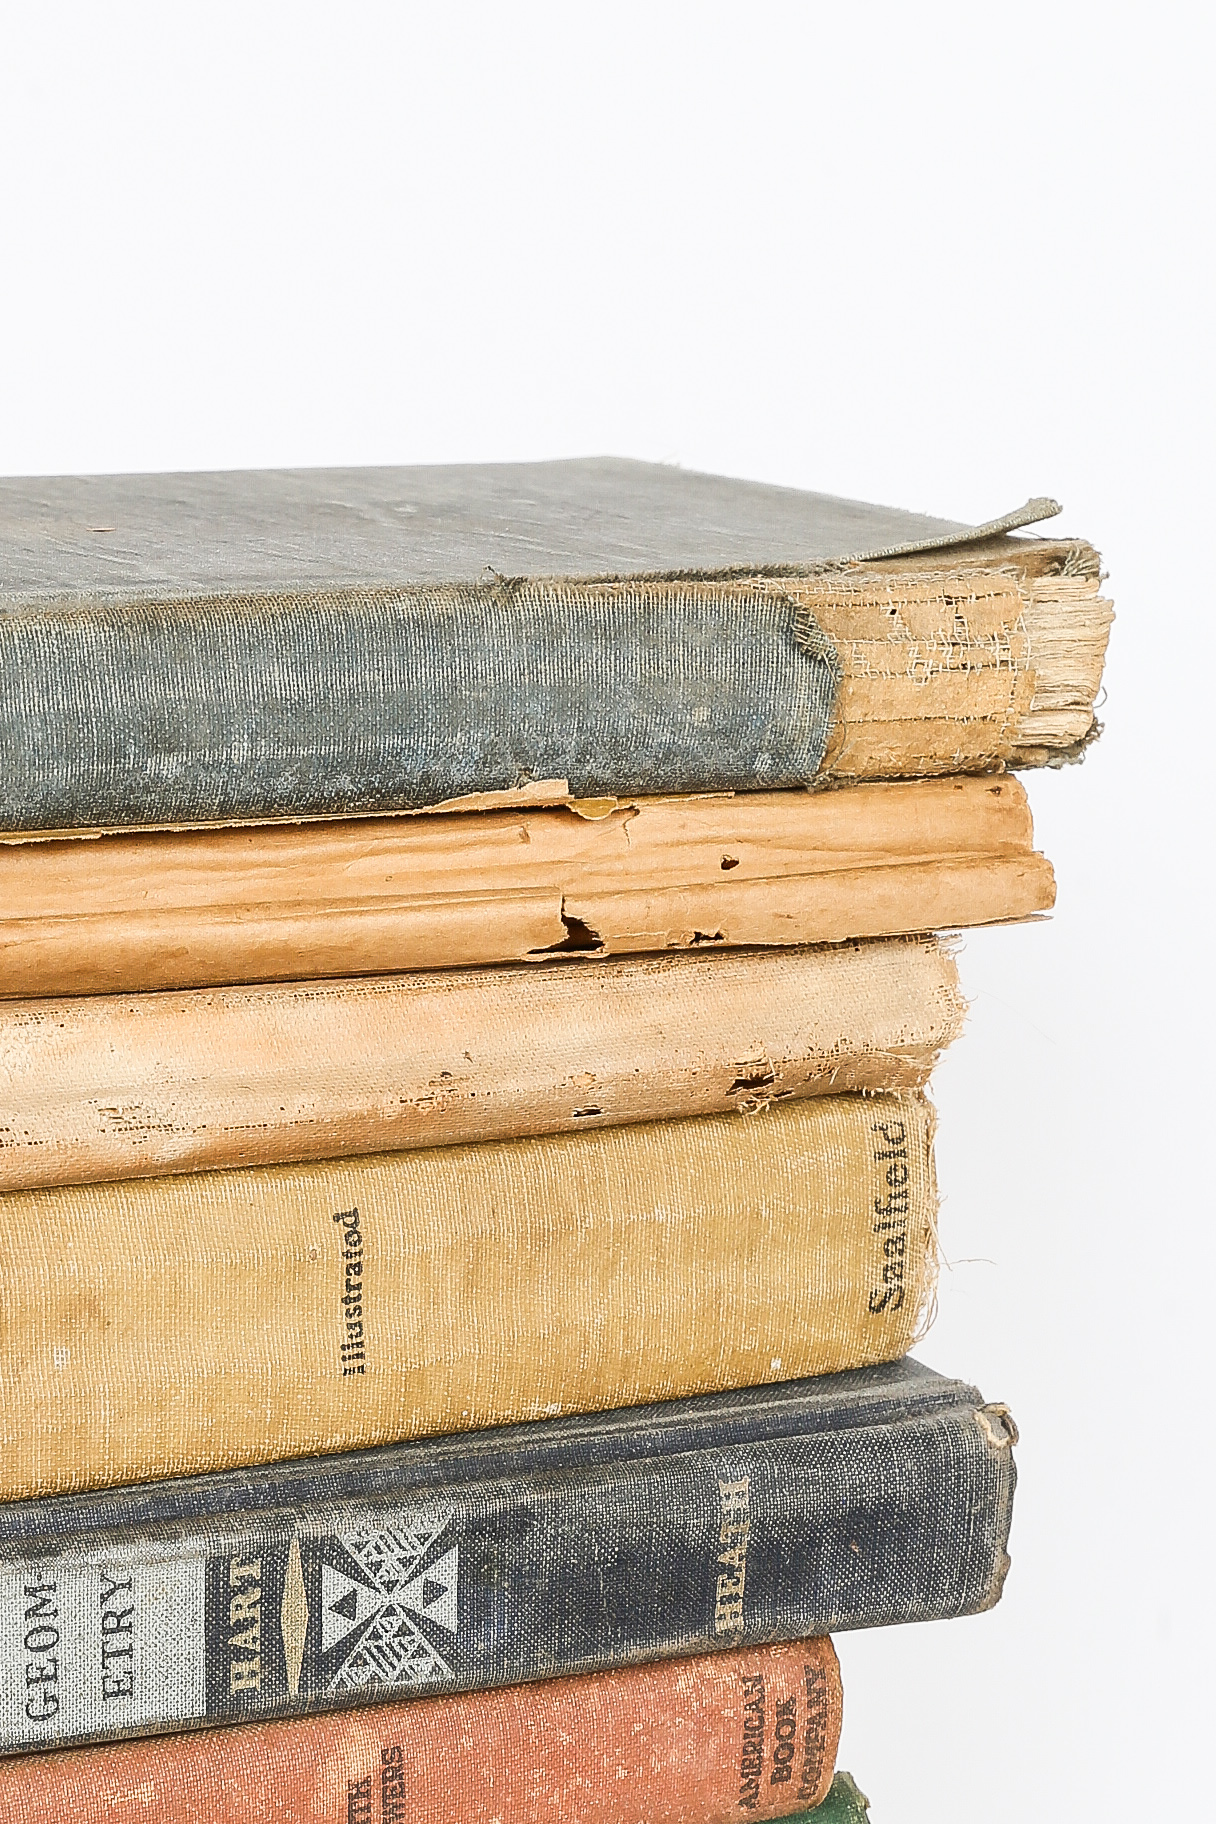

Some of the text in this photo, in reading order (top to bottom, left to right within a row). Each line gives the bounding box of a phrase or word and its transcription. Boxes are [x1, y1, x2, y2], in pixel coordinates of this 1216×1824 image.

[869, 1120, 910, 1314] Saalfield
[332, 1207, 366, 1377] Illustrated
[227, 1555, 263, 1696] HART
[713, 1474, 752, 1637] HEATH
[23, 1570, 60, 1724] GEOM-
[100, 1573, 136, 1704] ETRY
[737, 1674, 767, 1810] AMERICAN
[770, 1696, 798, 1785] BOOK
[798, 1664, 830, 1800] COMPANY
